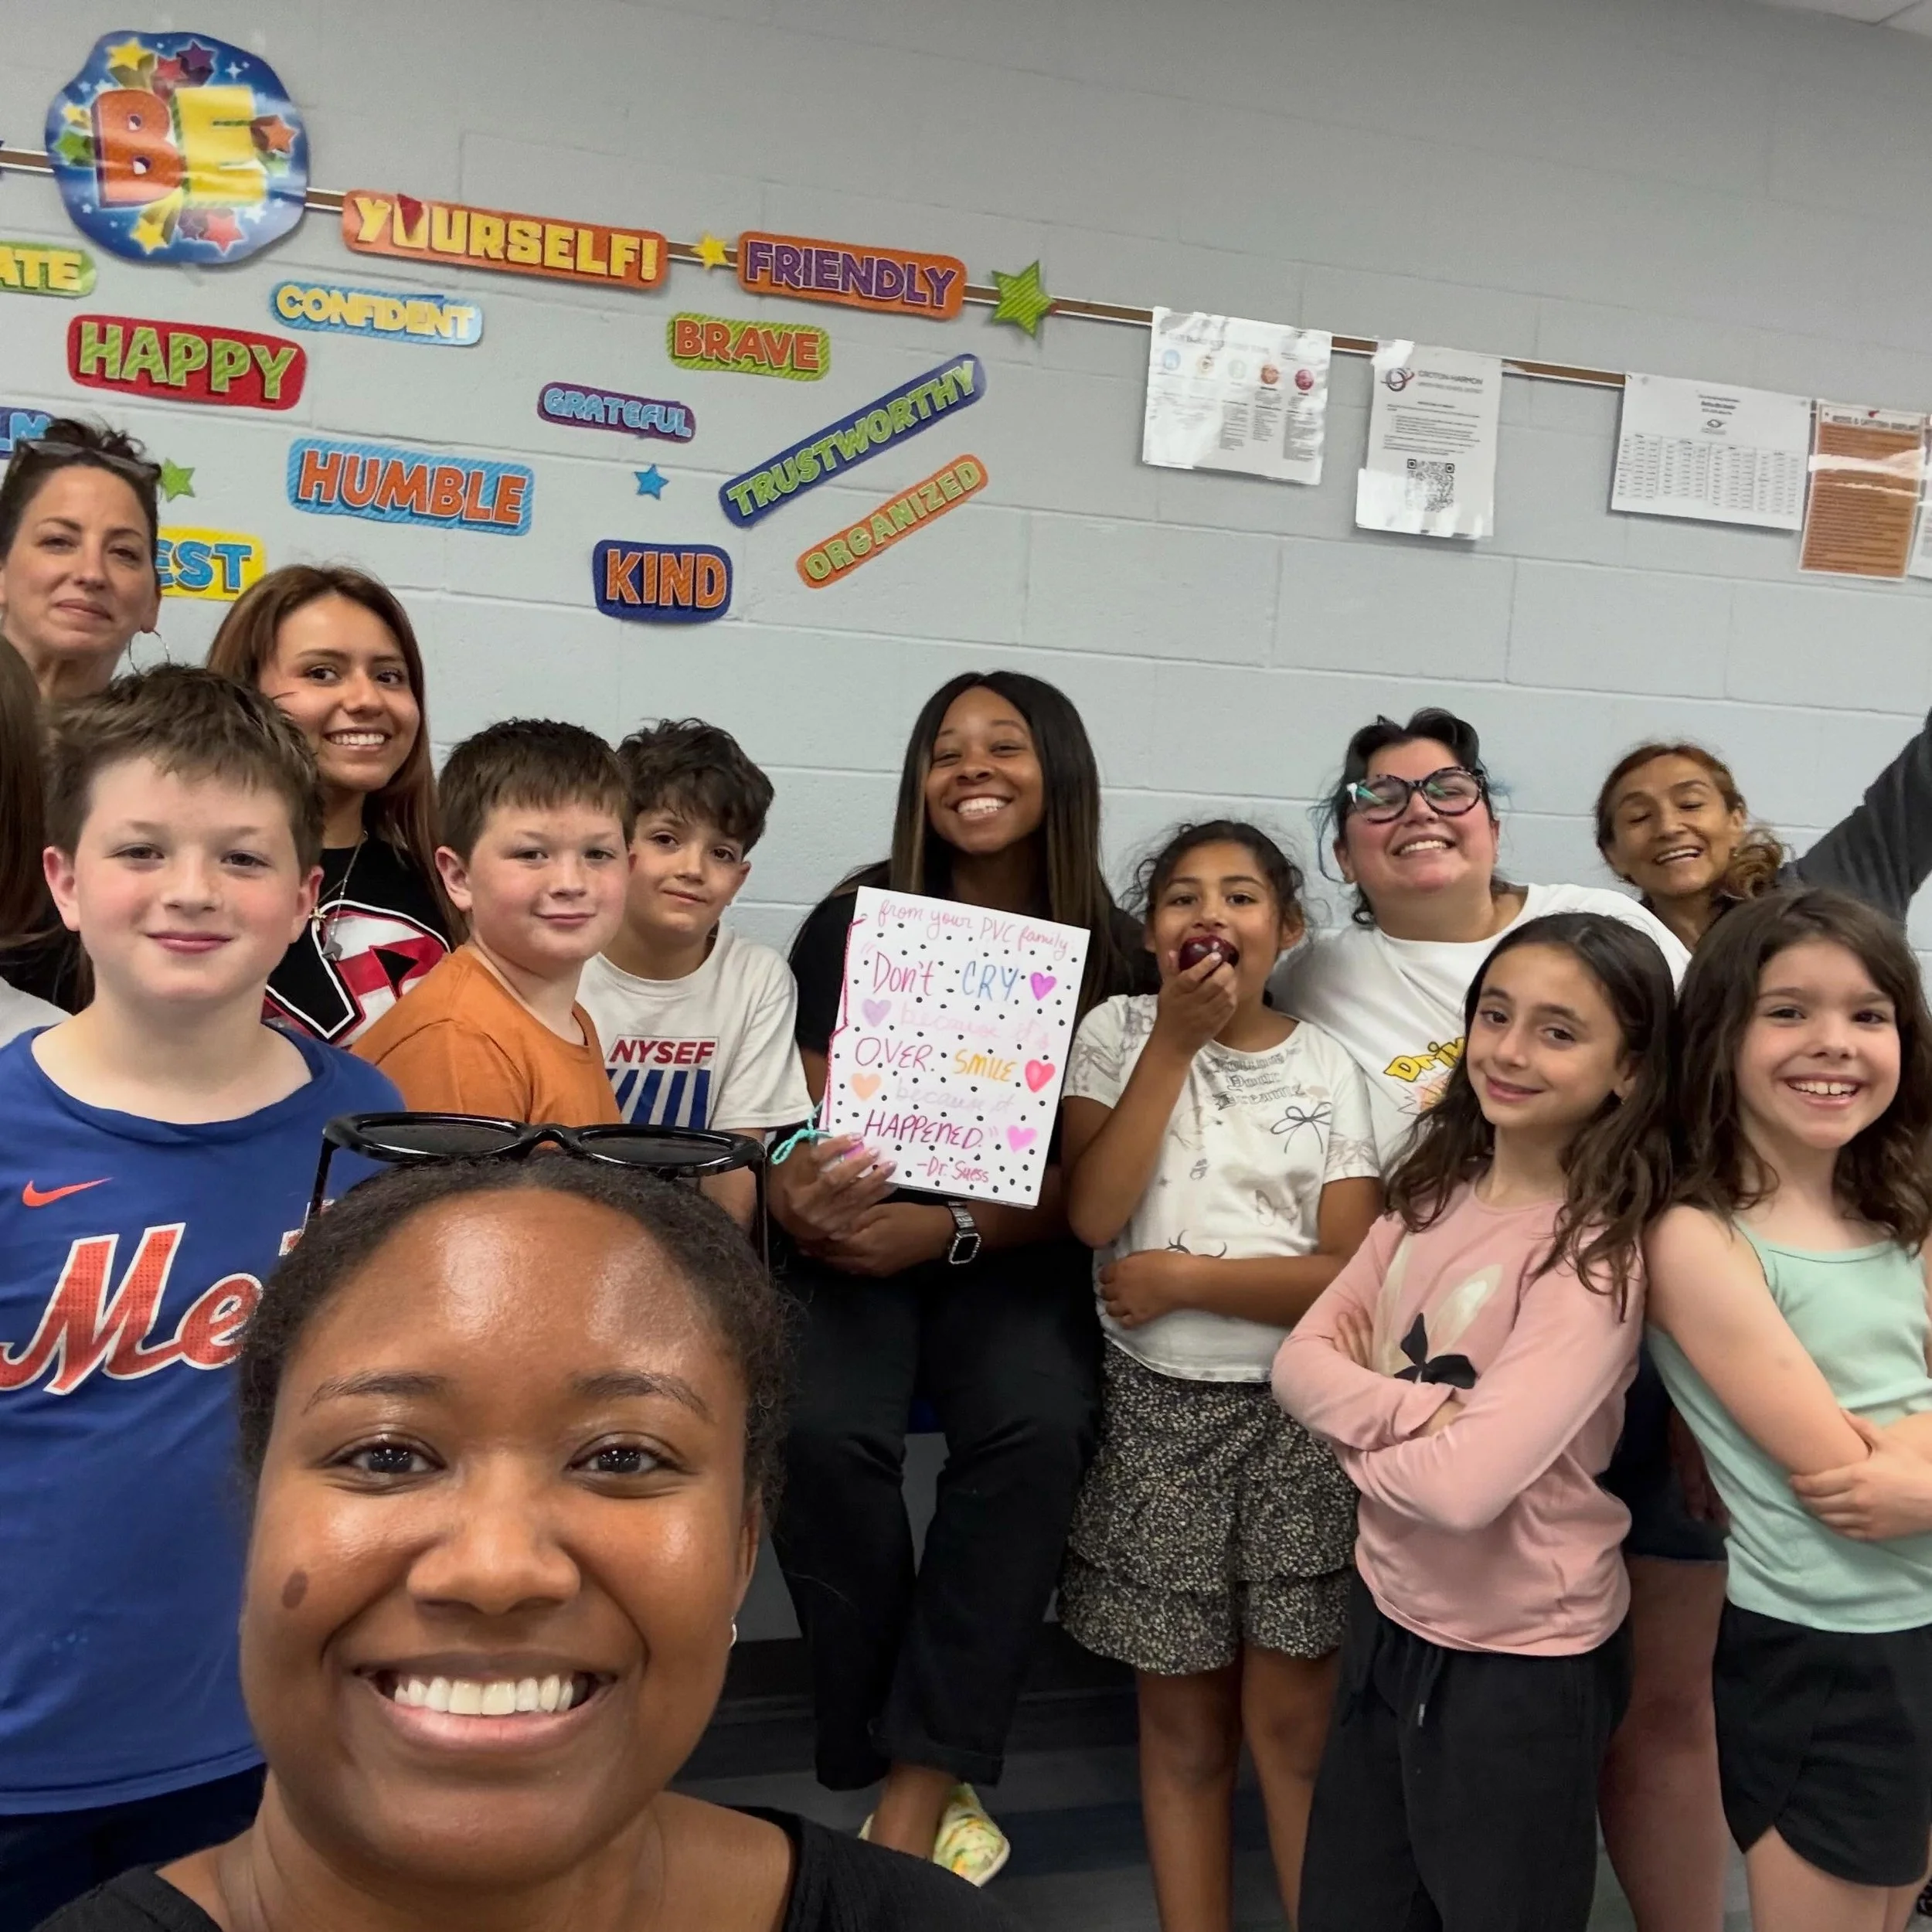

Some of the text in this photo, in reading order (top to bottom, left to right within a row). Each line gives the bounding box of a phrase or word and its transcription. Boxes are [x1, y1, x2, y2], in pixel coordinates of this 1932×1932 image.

[90, 85, 268, 207] BE
[353, 196, 658, 281] YOURSELF!
[747, 240, 957, 307] FRIENDLY
[277, 284, 474, 339] CONFIDENT
[673, 318, 820, 369] BRAVE
[79, 322, 298, 400] HAPPY
[543, 388, 692, 438] GRATEFUL
[728, 360, 975, 517] TRUSTWORTHY
[298, 449, 529, 526] HUMBLE
[805, 461, 981, 580] ORGANIZED
[605, 549, 727, 609] KIND
[878, 900, 1071, 961] from your PVC family
[962, 961, 1019, 1001] CRY
[609, 1039, 716, 1065] NYSEF
[953, 1049, 1017, 1082] SMILE
[0, 1222, 267, 1396] Me
